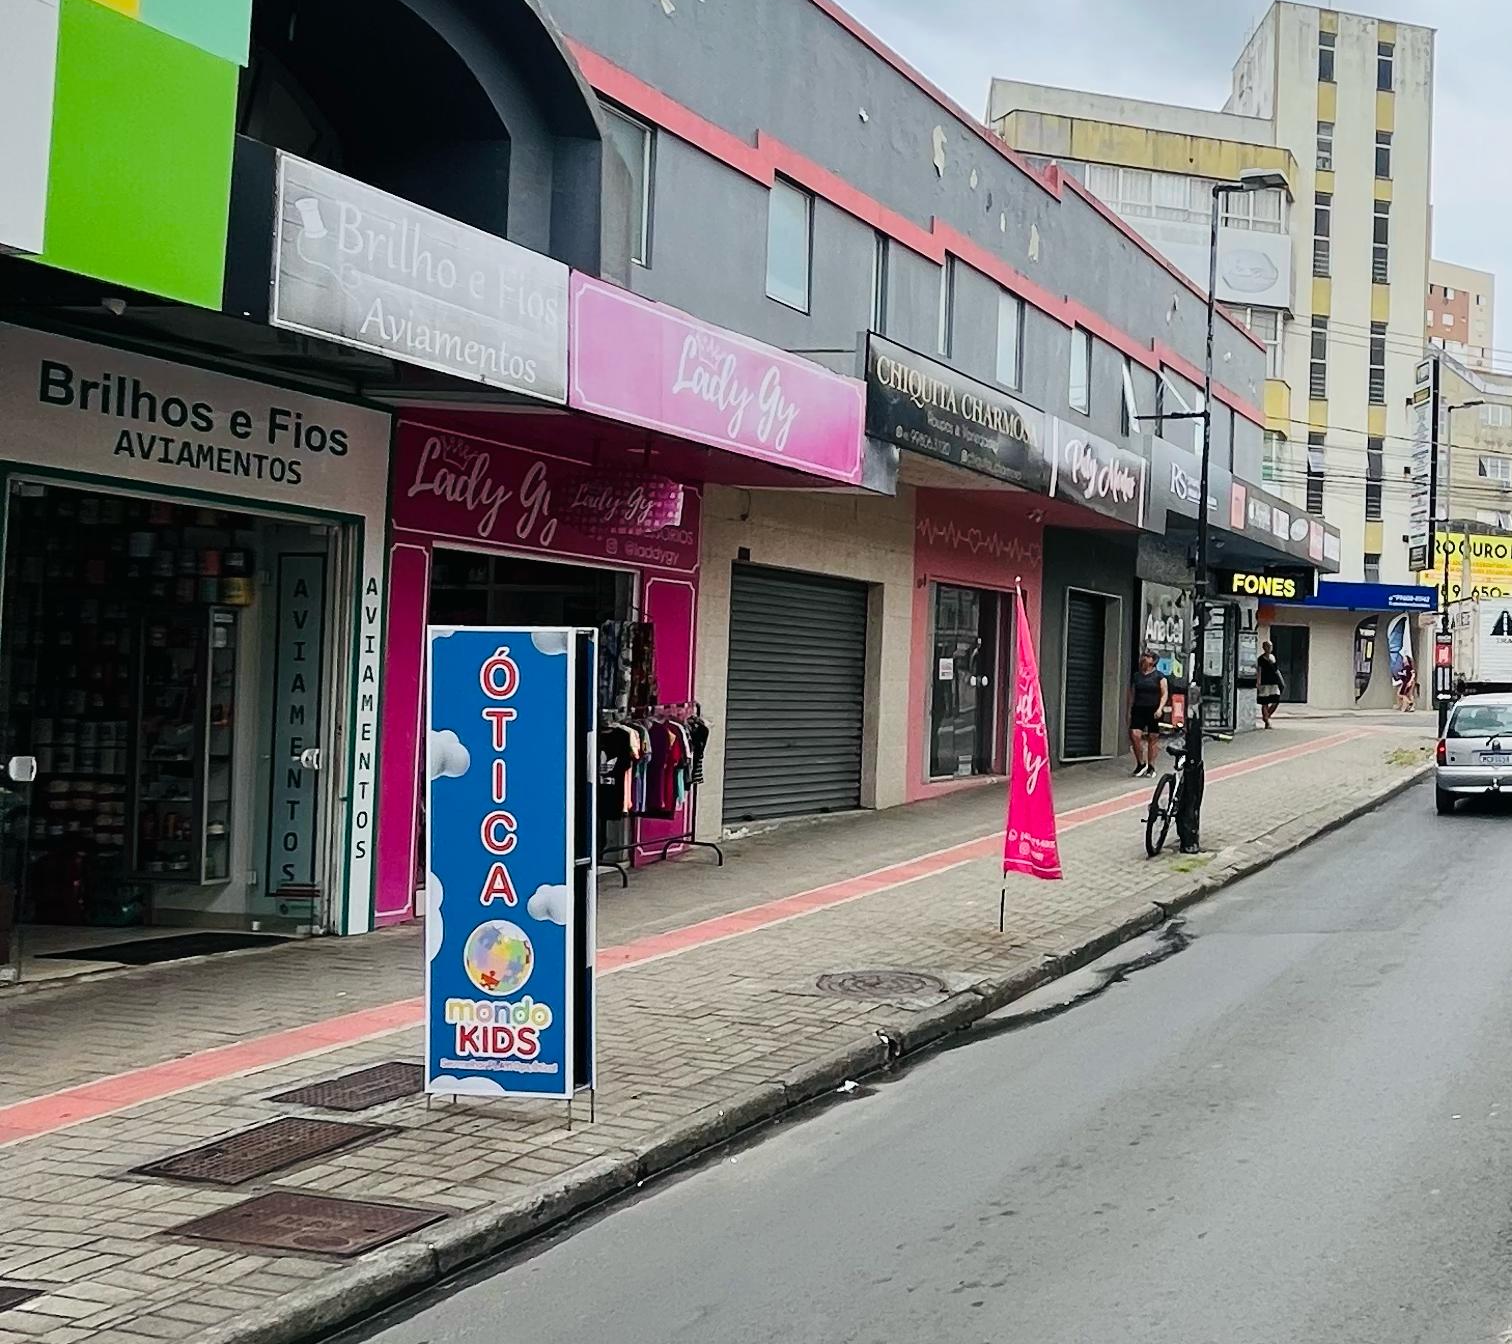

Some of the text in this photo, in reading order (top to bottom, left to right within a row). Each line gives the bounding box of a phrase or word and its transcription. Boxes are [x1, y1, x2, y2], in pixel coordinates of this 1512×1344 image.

[337, 201, 558, 326] Brilho e Fios
[360, 297, 537, 383] Aviamentos
[39, 359, 349, 457] Brilhos e Fios
[672, 334, 800, 451] Lady Gy
[876, 355, 959, 415] CHIQUITA
[961, 392, 1039, 447] CHARMOSA
[113, 429, 302, 485] AVIAMENTOS
[407, 436, 513, 537] Lady
[571, 483, 622, 521] Lady
[1232, 573, 1296, 598] FONES
[1459, 540, 1507, 558] OURO
[281, 578, 309, 883] AVIAMENTOS
[355, 577, 379, 859] AVIAMENTOS
[481, 647, 518, 905] ÓTICA
[447, 997, 550, 1027] mondo
[460, 1026, 537, 1056] KIDS
